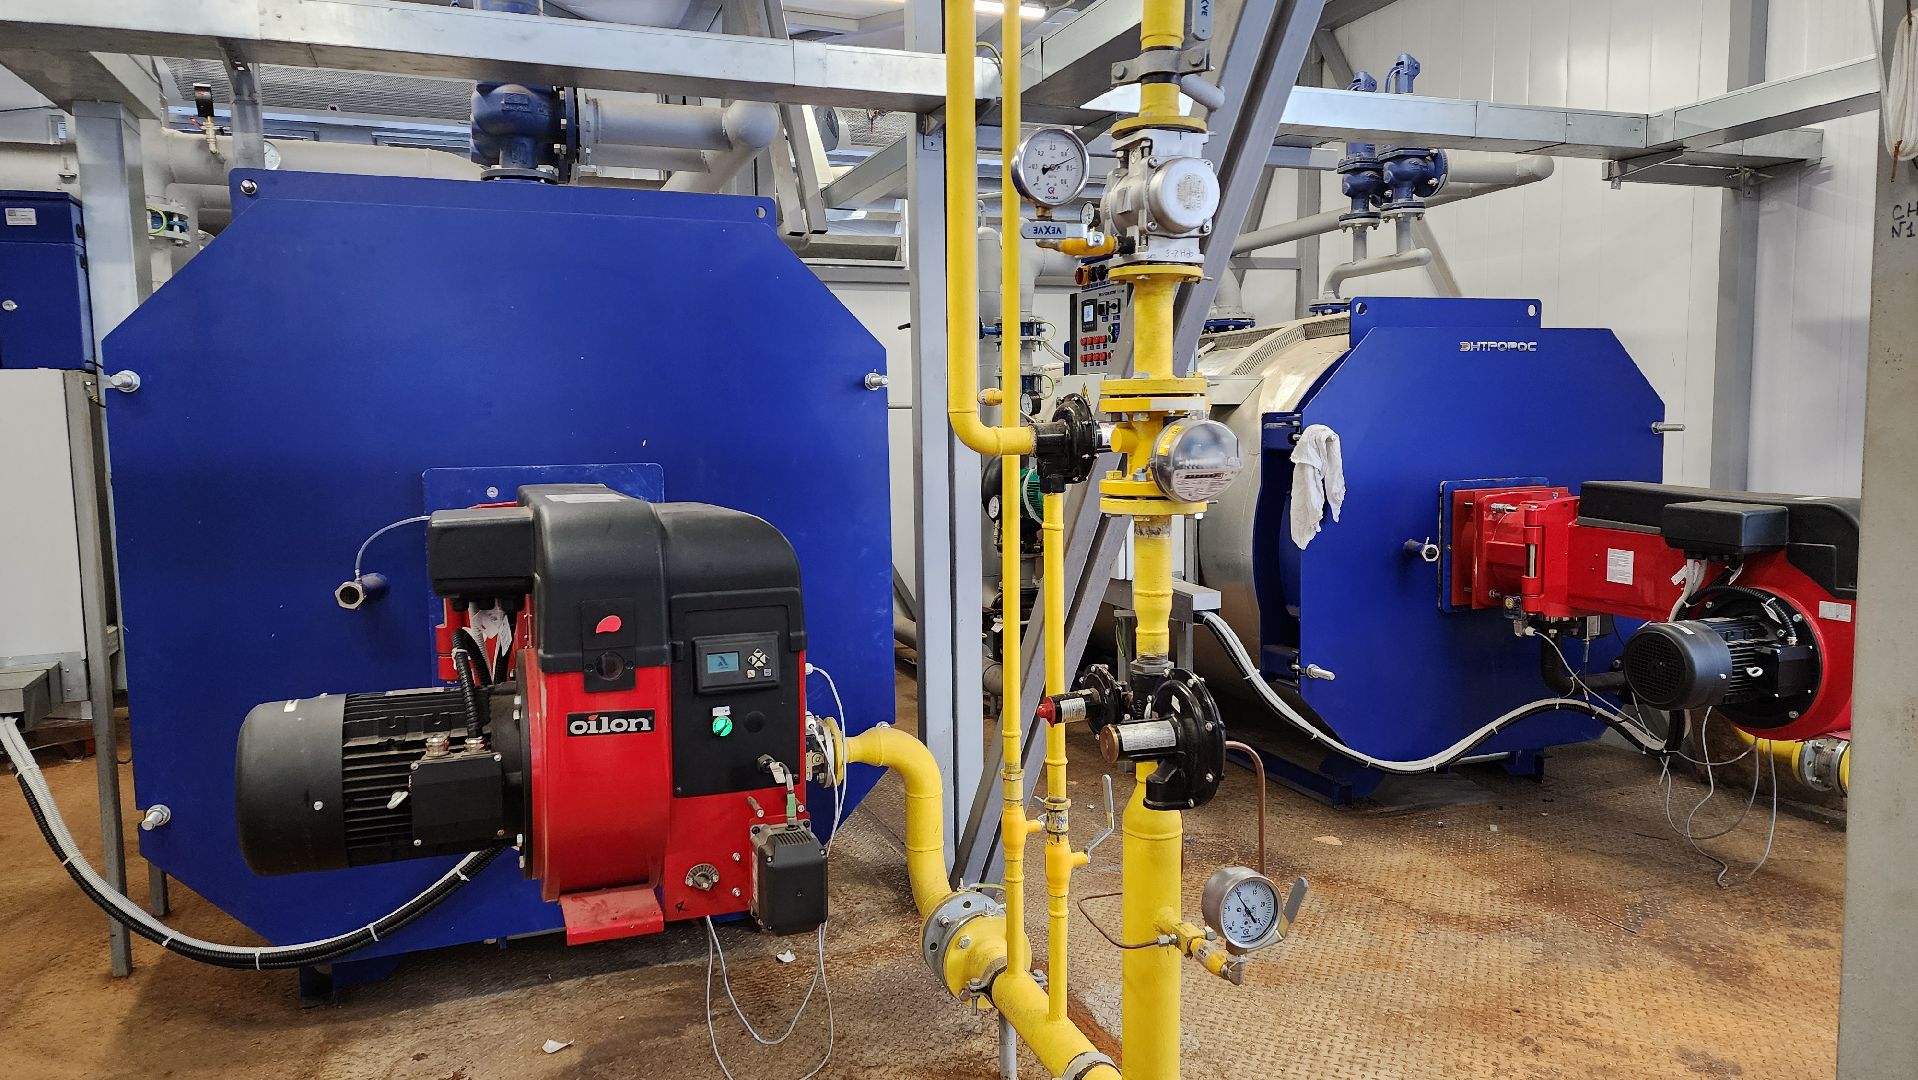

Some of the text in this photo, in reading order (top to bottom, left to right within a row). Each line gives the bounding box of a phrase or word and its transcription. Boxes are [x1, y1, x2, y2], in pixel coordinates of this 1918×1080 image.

[1032, 225, 1062, 235] VEXVE
[1459, 341, 1538, 352] ЭНТРОРОС
[569, 714, 652, 735] oilon
